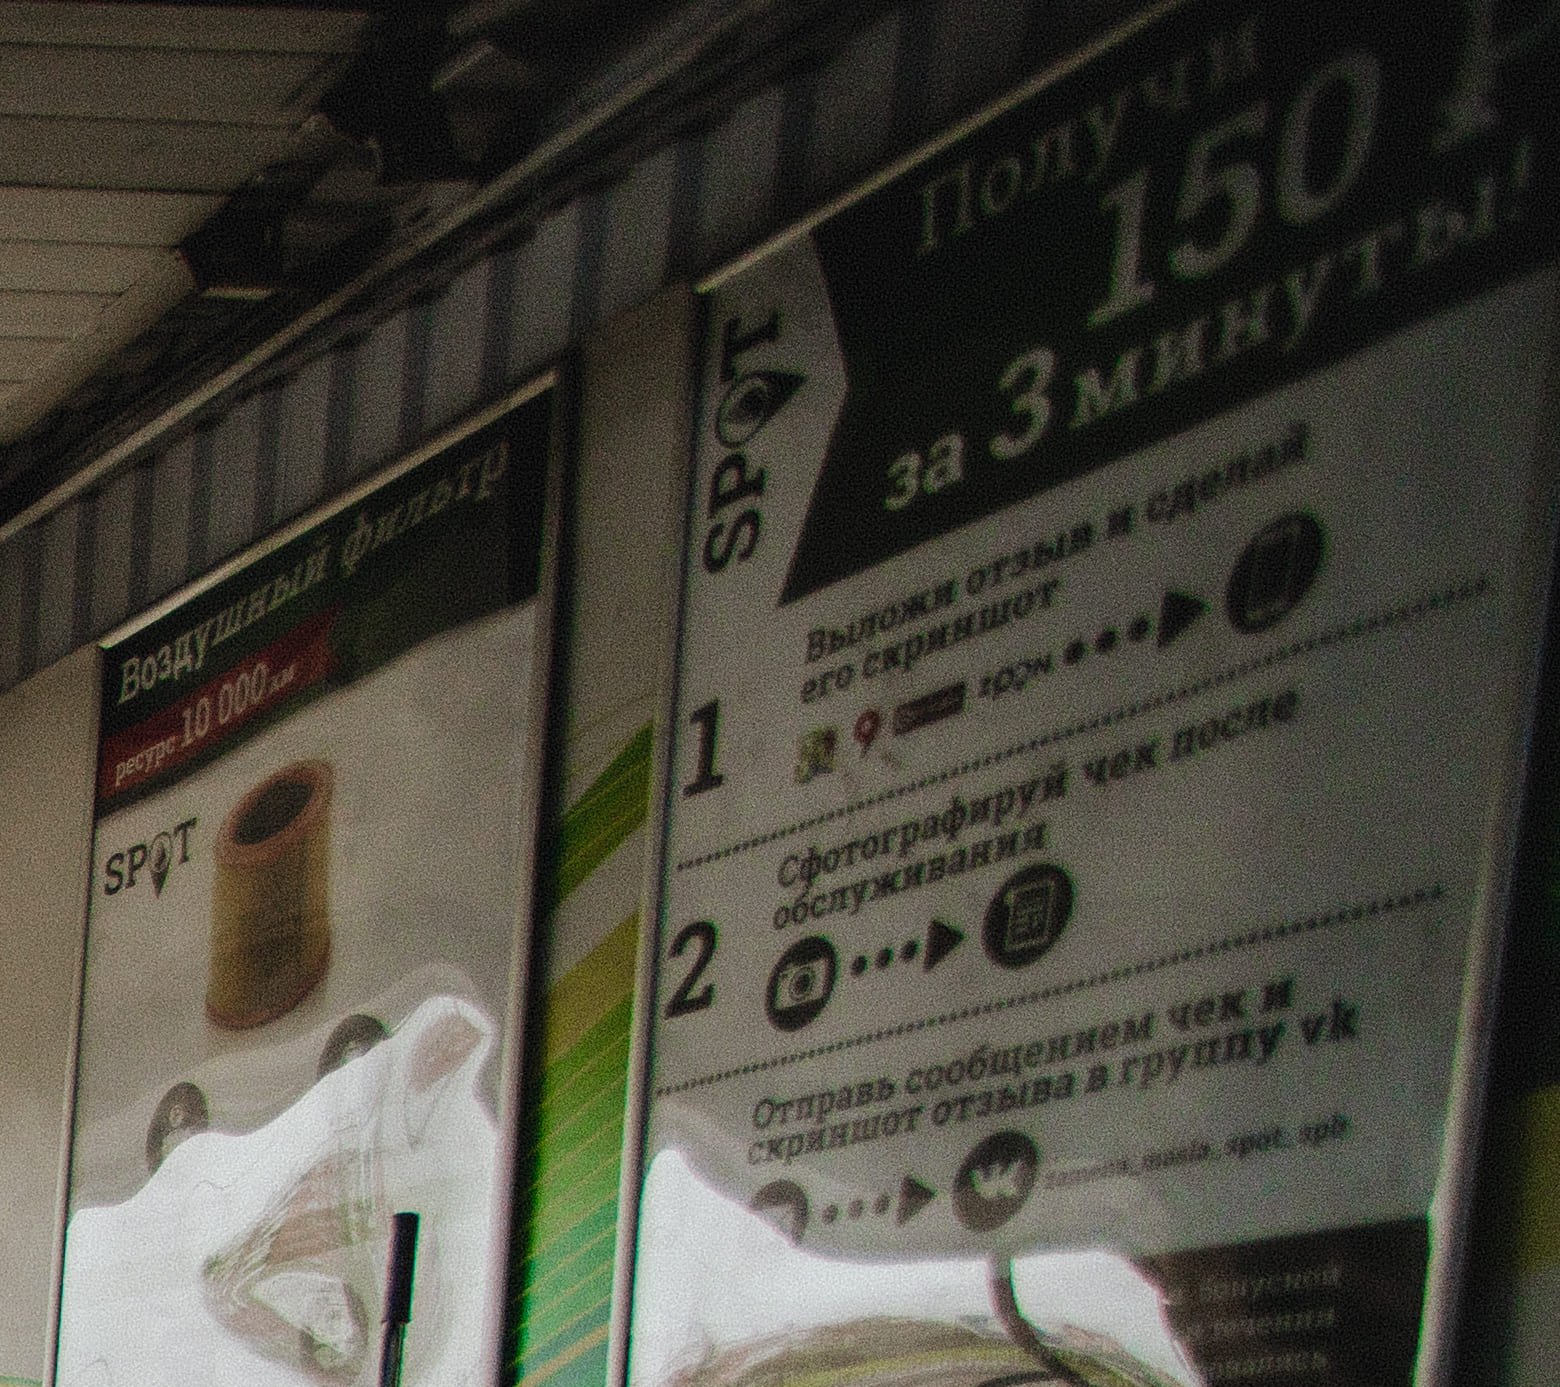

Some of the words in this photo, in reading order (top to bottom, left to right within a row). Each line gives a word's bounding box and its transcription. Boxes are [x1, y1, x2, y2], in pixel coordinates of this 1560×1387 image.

[919, 15, 1259, 257] Получи
[1085, 49, 1383, 331] 150
[702, 309, 806, 577] SPOT
[884, 432, 966, 512] за
[989, 345, 1055, 461] 3
[119, 534, 330, 703] Воздушный
[342, 440, 509, 577] фильтр
[801, 664, 853, 704] его
[862, 578, 1060, 680] скриншот
[805, 577, 957, 665] Выложи
[966, 522, 1095, 597] отзыв
[1107, 504, 1133, 540] и
[183, 700, 210, 745] 10
[220, 662, 267, 724] 000
[682, 697, 726, 798] 1
[103, 817, 199, 899] SPOT
[773, 821, 1048, 931] обслуживания
[777, 760, 1069, 893] Сфотографируй
[663, 919, 719, 1021] 2
[747, 1106, 924, 1165] скриншот
[930, 1071, 1075, 1127] отзыва
[1086, 1062, 1109, 1091] в
[1118, 1020, 1286, 1086] группу
[752, 1072, 895, 1131] Отправь
[904, 1010, 1155, 1097] сообщением
[1169, 989, 1247, 1032] чек
[1259, 975, 1295, 1012] и
